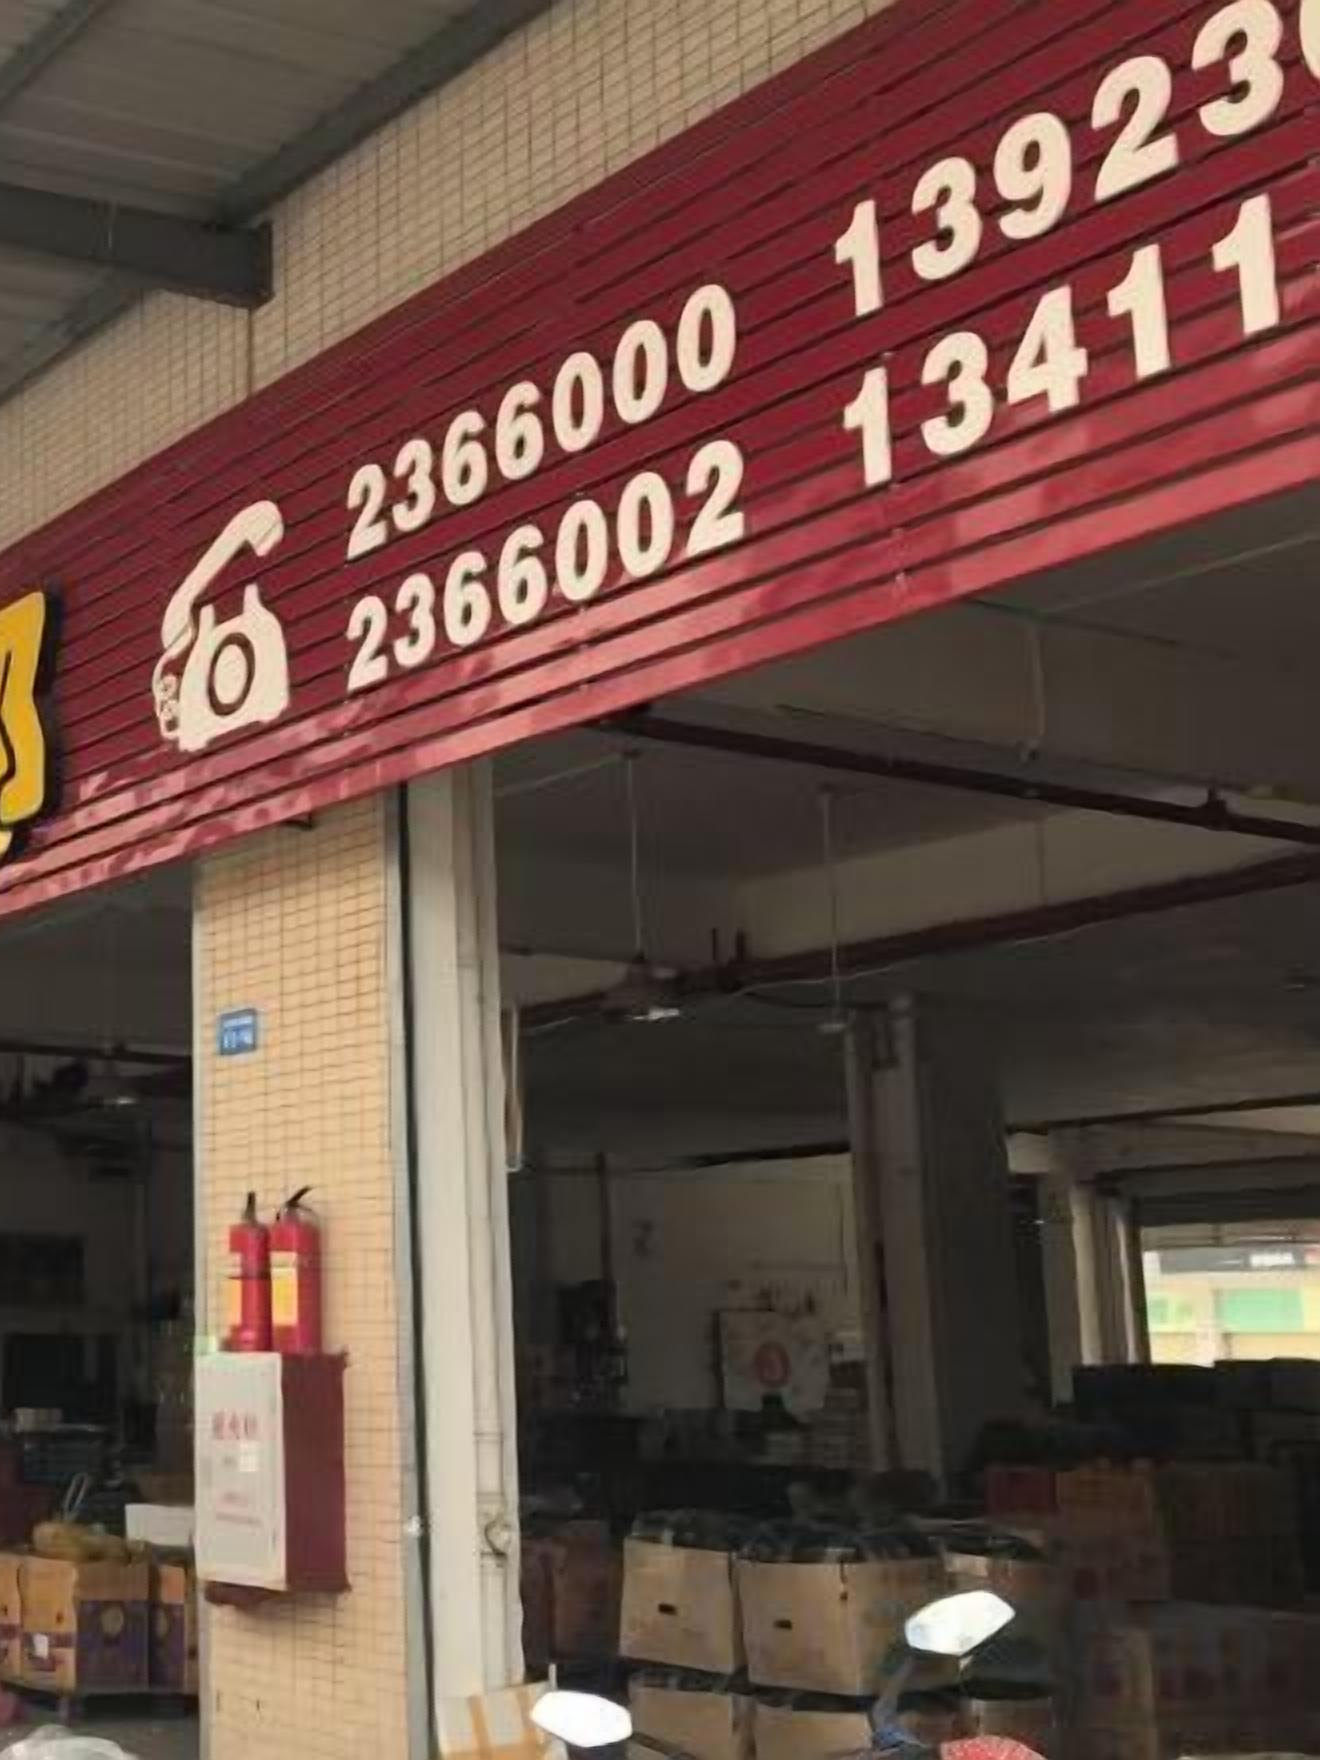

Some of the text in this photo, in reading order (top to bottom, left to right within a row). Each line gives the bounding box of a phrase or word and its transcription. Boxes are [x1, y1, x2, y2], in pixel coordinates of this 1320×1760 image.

[347, 0, 1320, 561] 2366000 13923
[347, 193, 1280, 692] 2366002 13411
